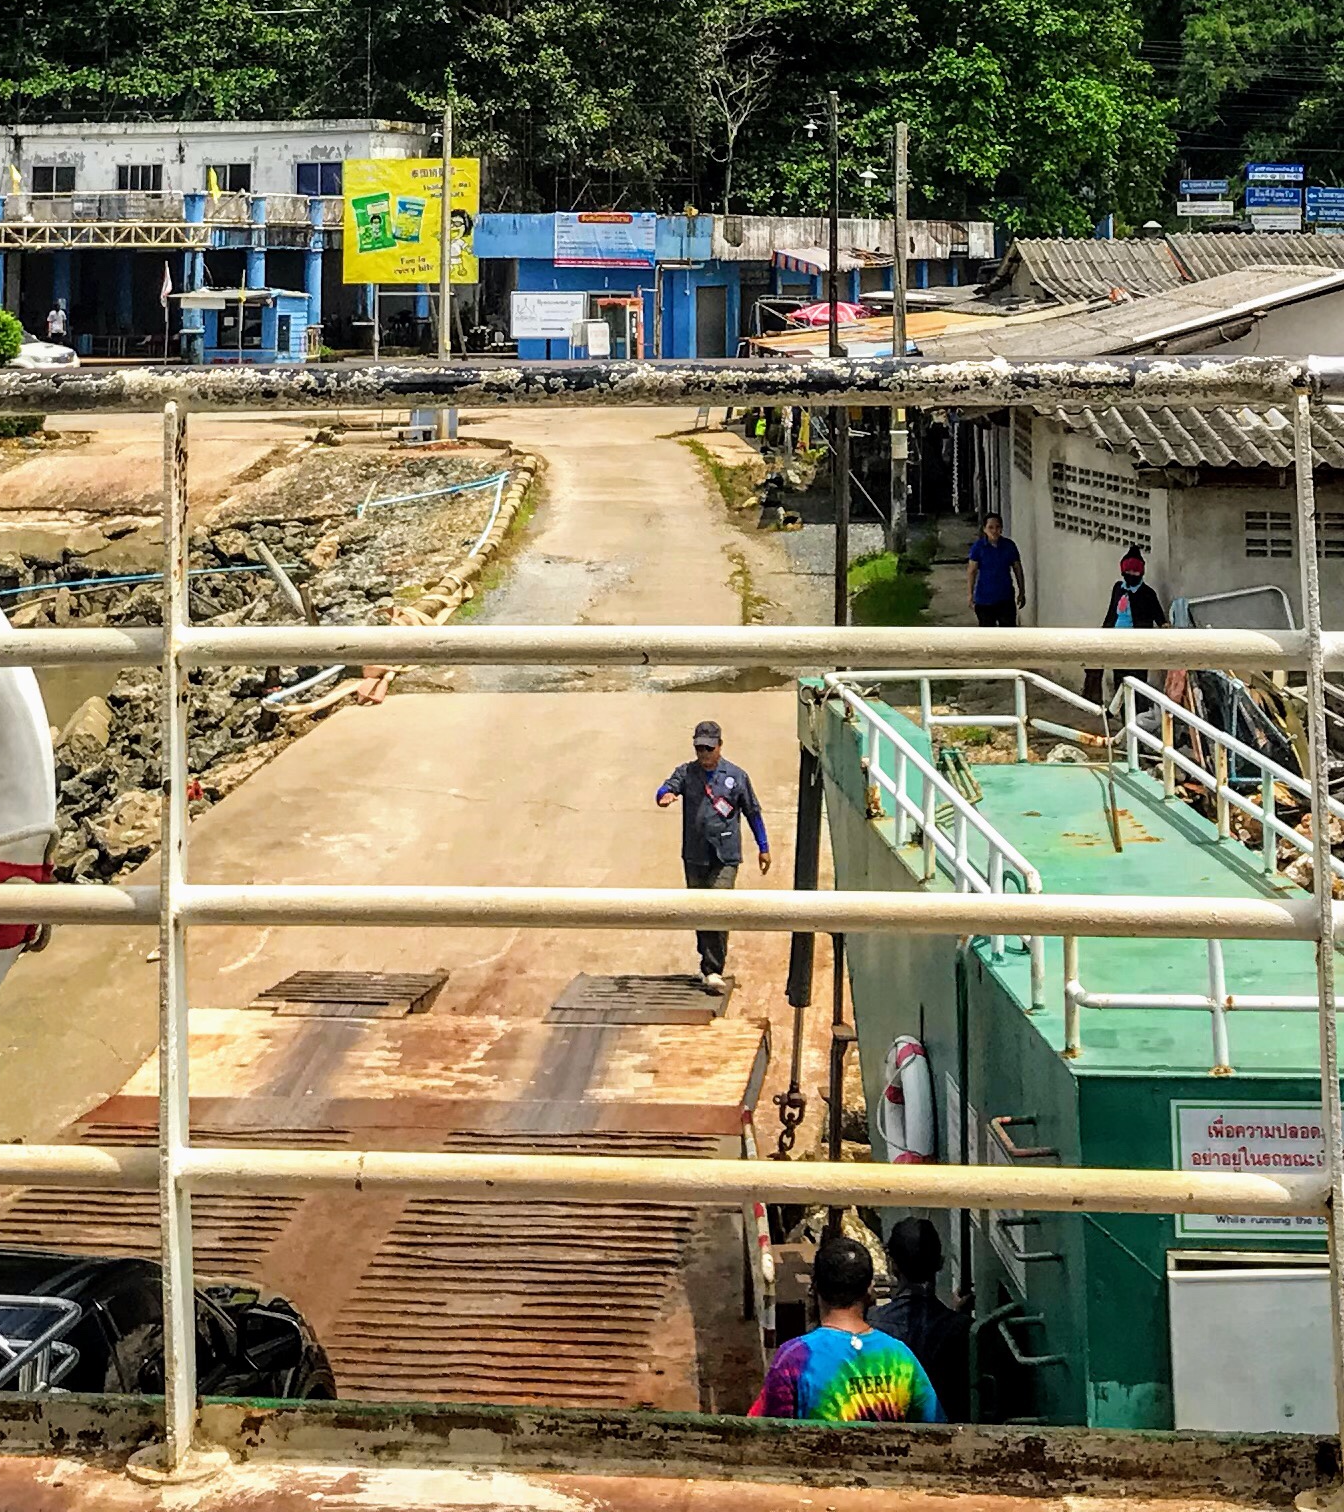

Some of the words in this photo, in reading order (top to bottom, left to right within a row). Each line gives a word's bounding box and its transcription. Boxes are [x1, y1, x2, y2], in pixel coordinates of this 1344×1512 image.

[1216, 1215, 1246, 1224] While
[1251, 1216, 1291, 1226] running
[1296, 1215, 1312, 1225] the
